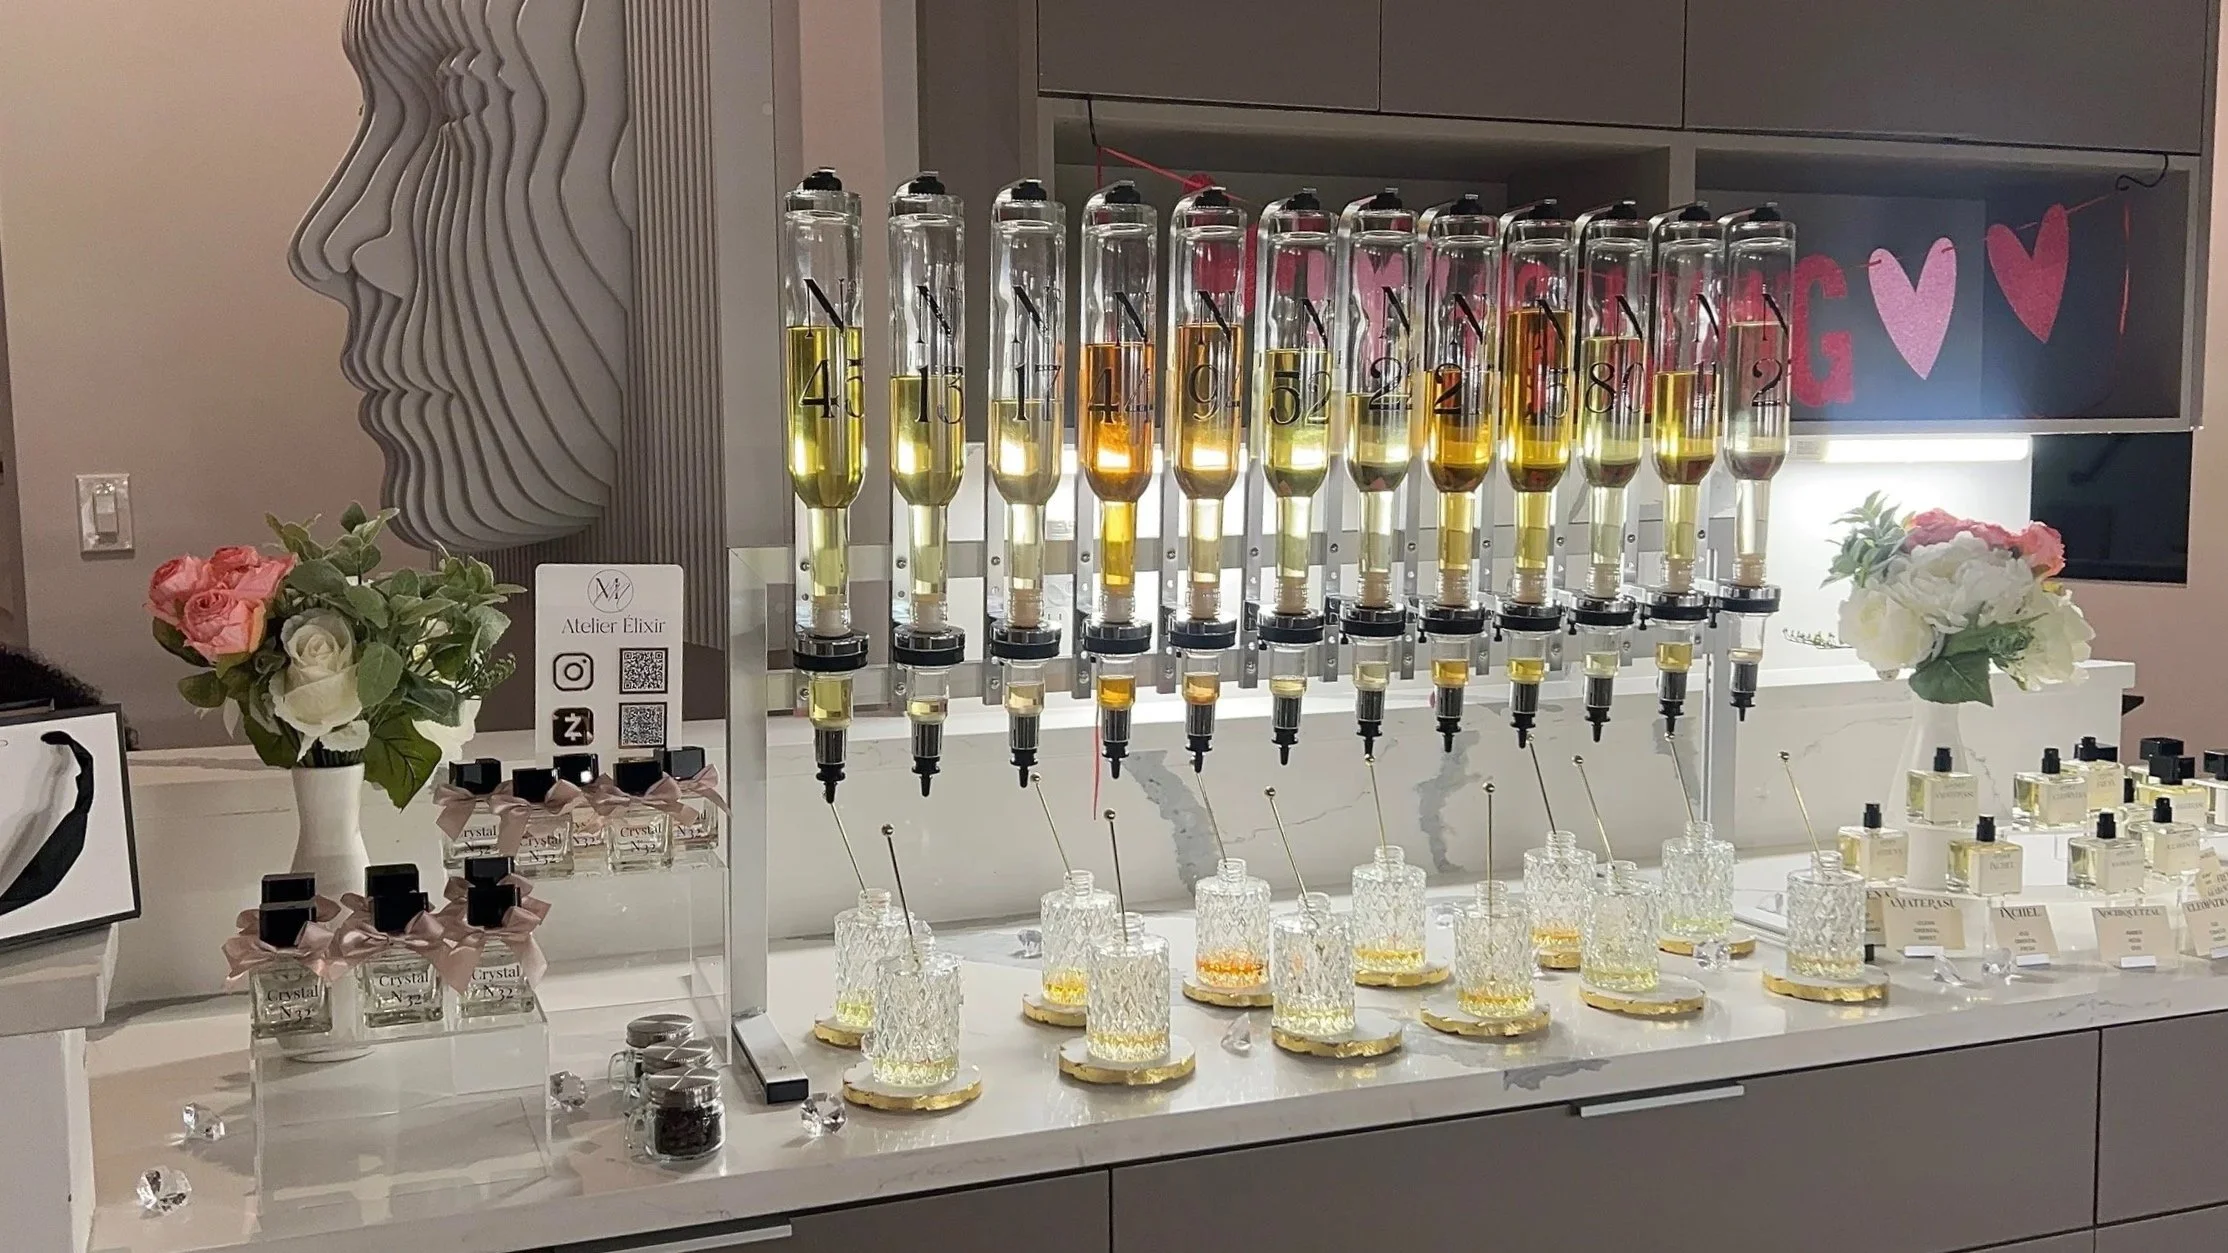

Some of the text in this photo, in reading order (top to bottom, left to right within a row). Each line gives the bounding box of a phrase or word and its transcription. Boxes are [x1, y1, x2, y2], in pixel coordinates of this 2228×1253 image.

[561, 617, 618, 635] Atelier
[463, 825, 497, 839] rystal
[378, 971, 429, 988] Crystal
[471, 964, 521, 982] Crystal
[266, 984, 319, 1002] Crystal
